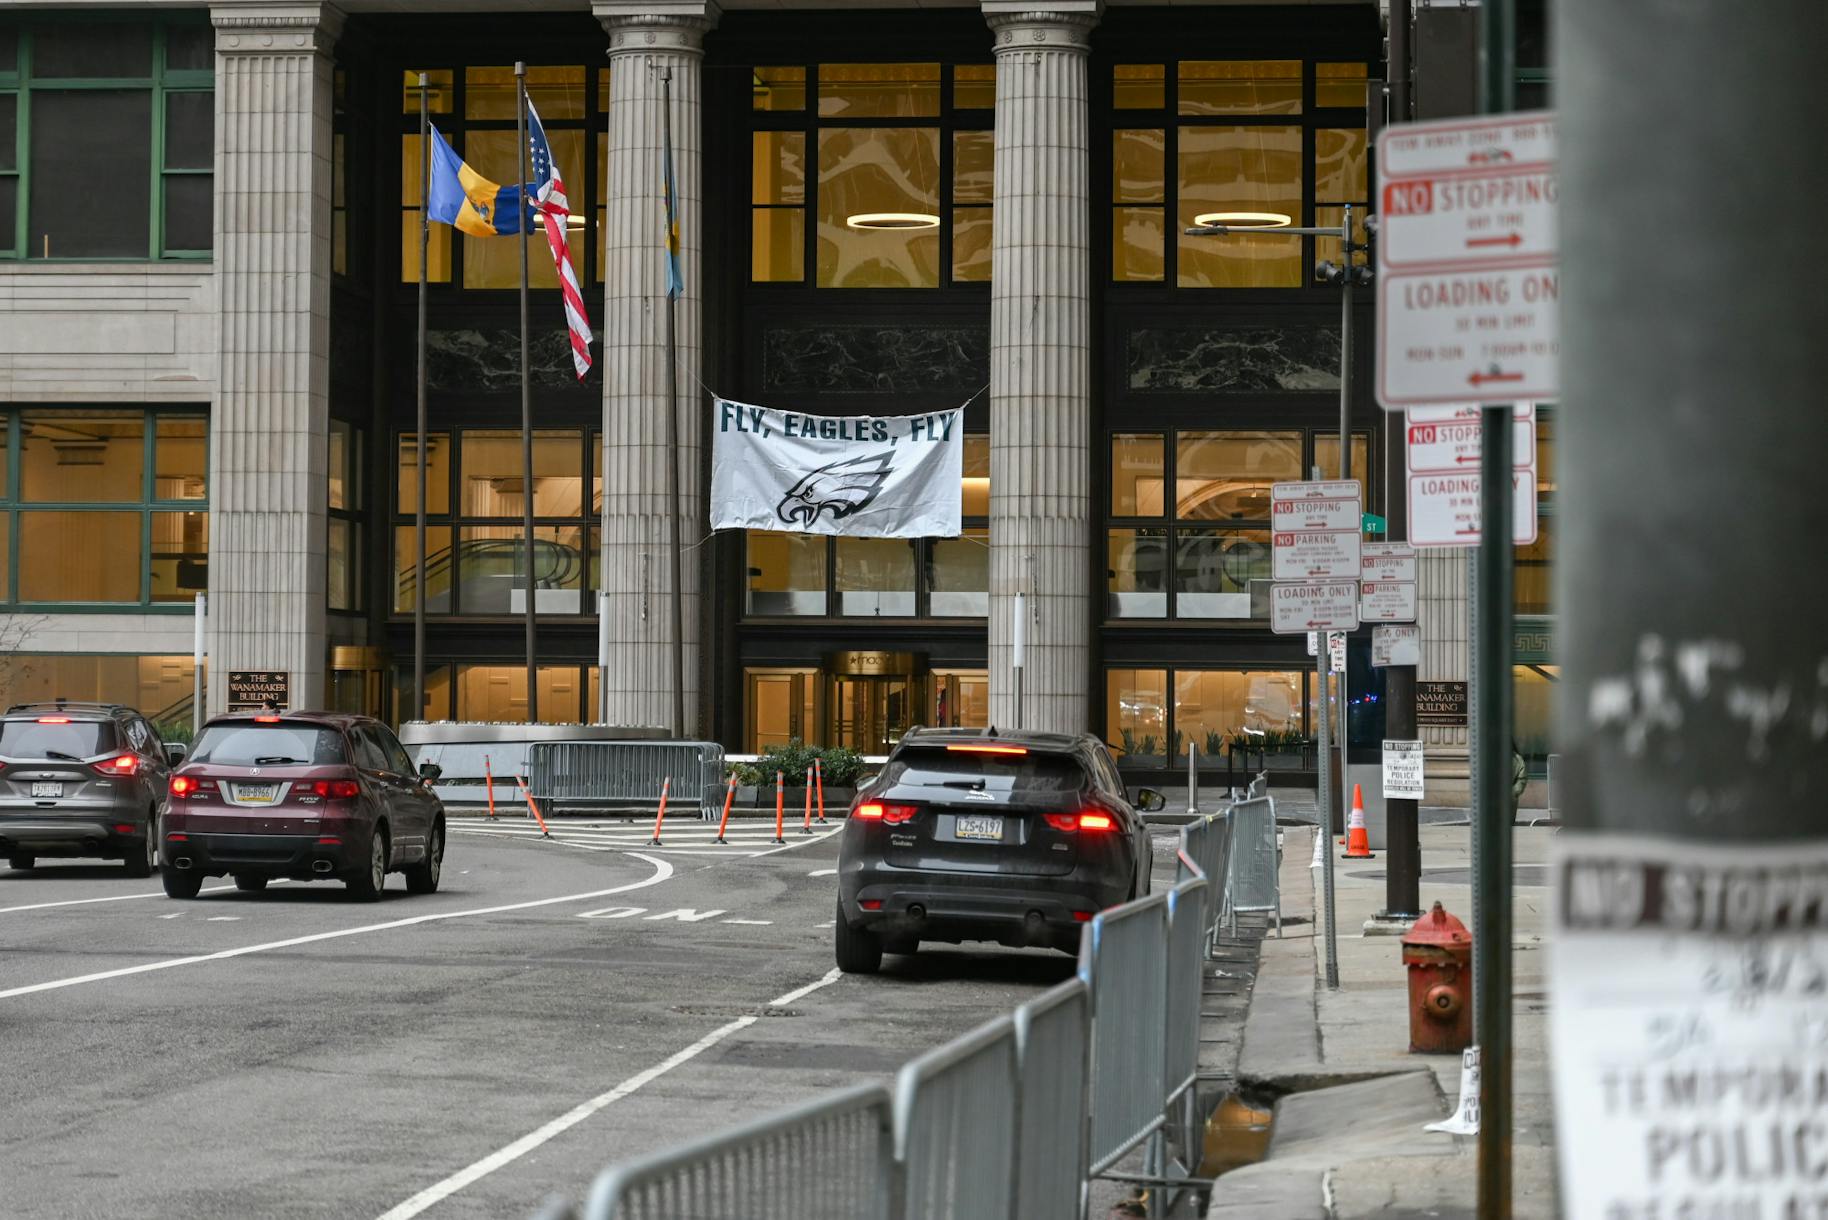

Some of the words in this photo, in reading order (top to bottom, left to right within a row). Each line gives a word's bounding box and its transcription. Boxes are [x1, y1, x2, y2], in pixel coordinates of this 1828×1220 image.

[1391, 184, 1430, 214] NO
[1440, 177, 1559, 211] STOPPING
[1405, 277, 1511, 310] LOADING
[1523, 273, 1559, 303] ON
[721, 403, 771, 438] FLY,
[784, 414, 898, 446] EAGLES,
[911, 412, 957, 442] FLY
[1413, 427, 1434, 443] NO
[1440, 426, 1481, 442] STOPP
[1421, 479, 1480, 495] LOADING
[1277, 502, 1292, 513] NO
[1295, 502, 1341, 513] STOPPING
[1367, 522, 1376, 531] ST
[1278, 535, 1292, 546] NO
[1296, 534, 1336, 545] PARKING
[1363, 560, 1373, 568] NO
[1375, 559, 1404, 567] STOPPING
[1277, 587, 1325, 599] LOADING
[1329, 586, 1352, 597] ONLY
[1363, 584, 1373, 593] NO
[1375, 584, 1400, 592] PARKING
[1395, 628, 1416, 638] ONLY
[249, 674, 268, 683] THE
[230, 683, 286, 692] WANAMAKER
[1427, 684, 1446, 693] THE
[239, 692, 279, 701] BUILDING
[1416, 702, 1458, 711] BUILDING
[1394, 743, 1422, 751] STOPPING
[1391, 771, 1414, 779] POLICE
